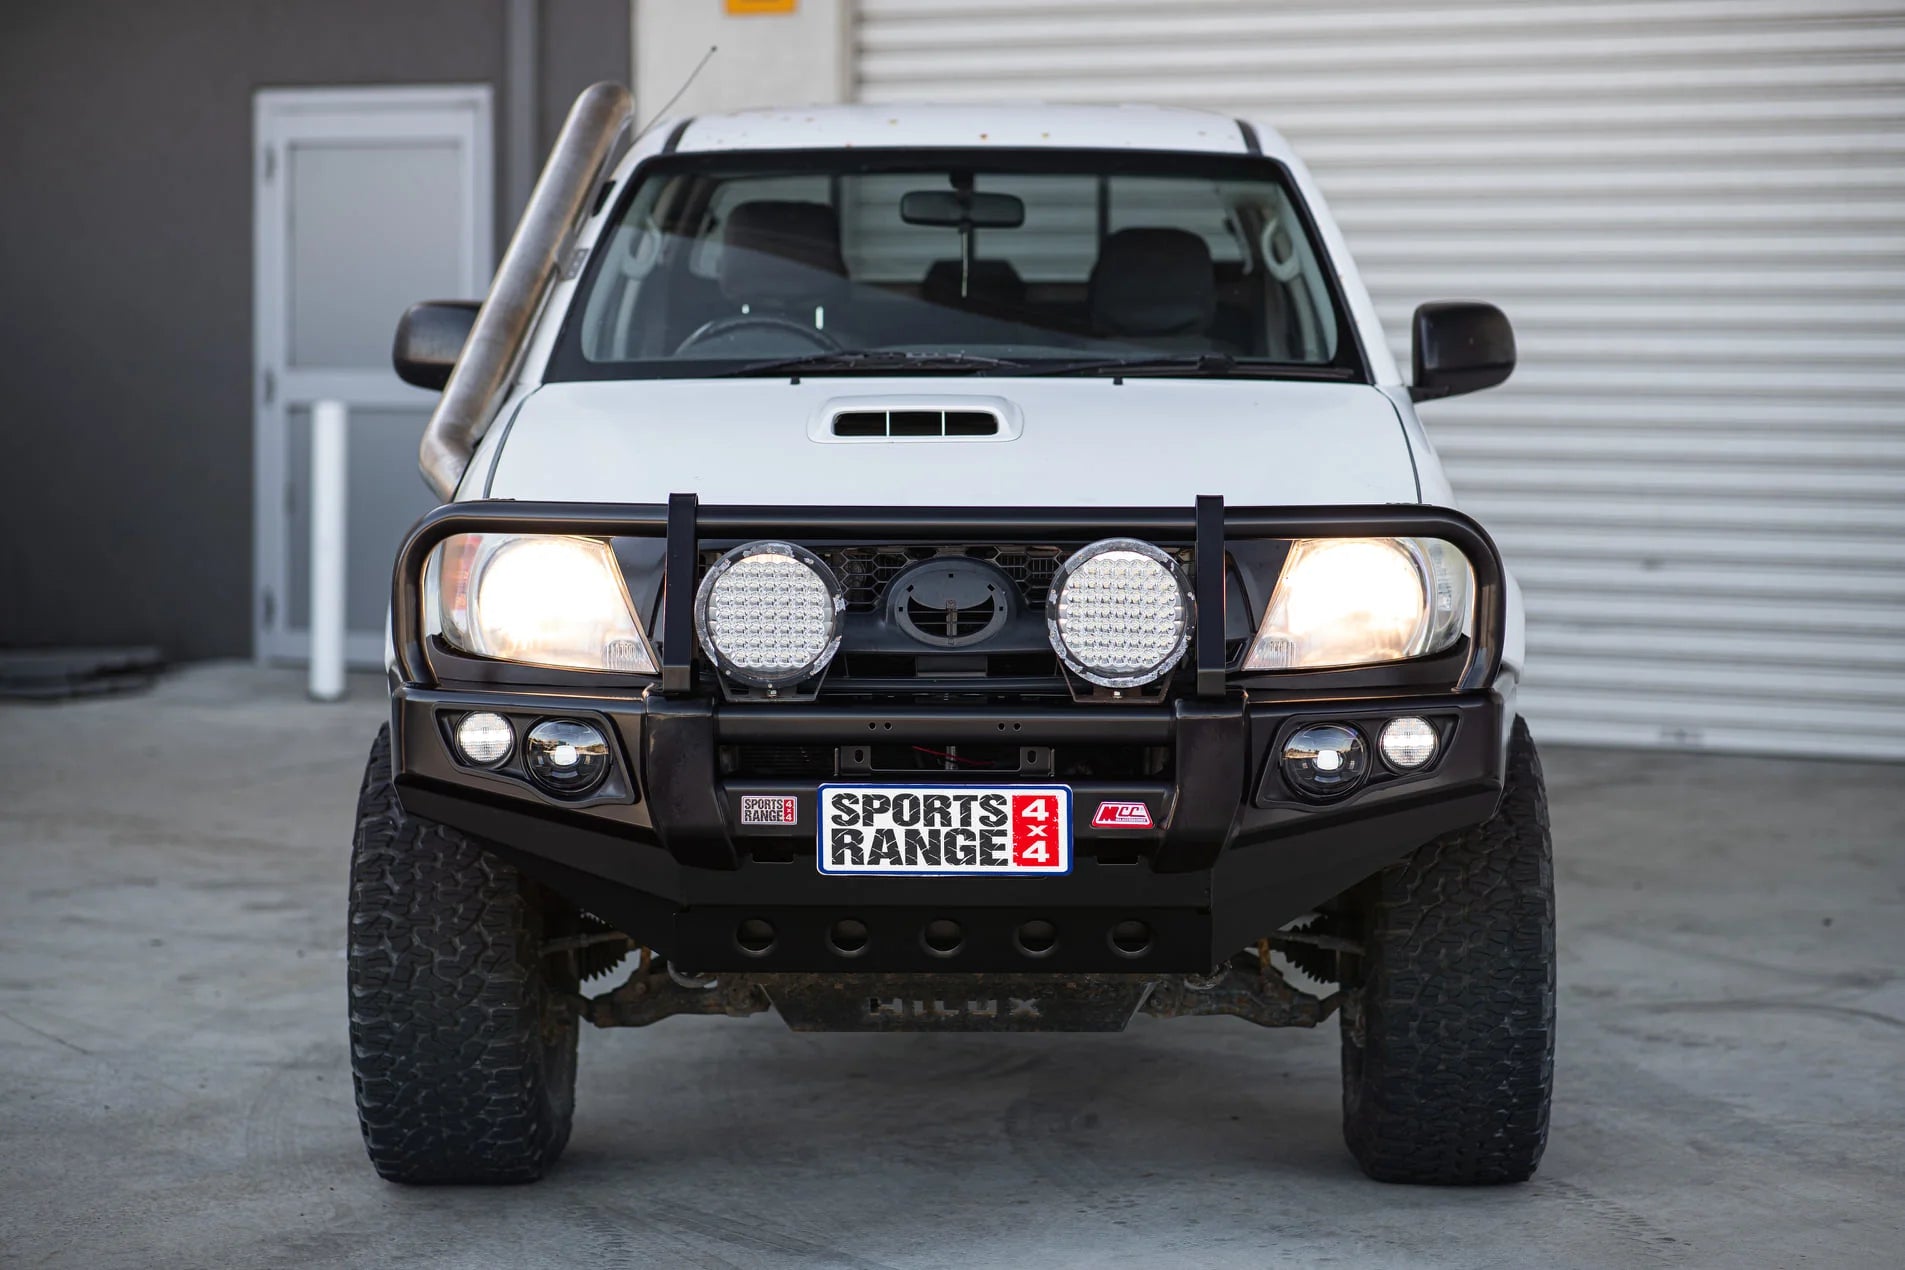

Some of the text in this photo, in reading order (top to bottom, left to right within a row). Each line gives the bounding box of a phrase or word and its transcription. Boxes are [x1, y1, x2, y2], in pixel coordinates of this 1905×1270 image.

[744, 798, 783, 810] SPORTS
[831, 793, 1008, 828] SPORTS
[744, 809, 783, 822] RANGE
[831, 828, 1009, 866] RANGE
[866, 998, 1040, 1017] HILUX
